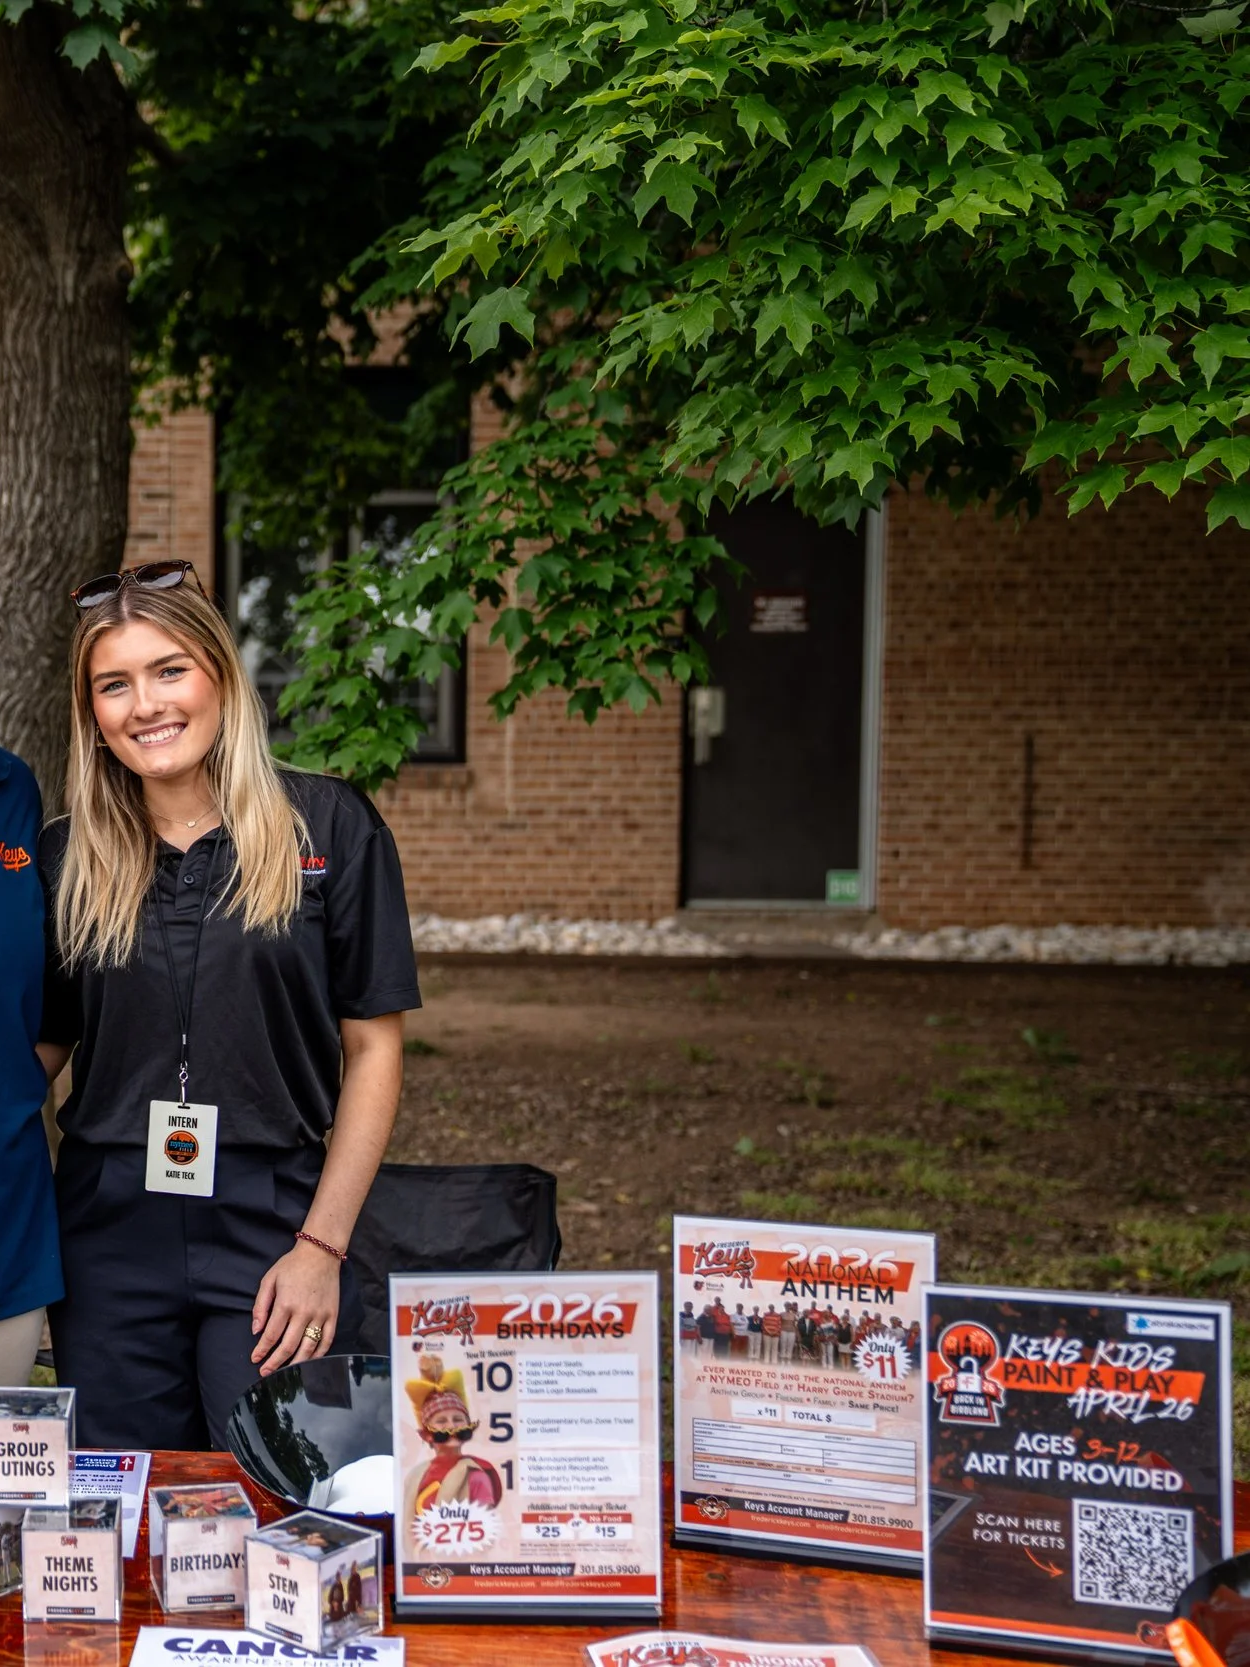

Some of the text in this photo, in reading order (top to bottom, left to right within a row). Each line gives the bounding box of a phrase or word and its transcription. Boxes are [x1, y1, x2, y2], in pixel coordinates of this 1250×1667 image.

[168, 1115, 198, 1129] INTERN
[165, 1170, 195, 1180] KATIE TECK
[716, 1240, 750, 1249] FREDERICK
[694, 1241, 756, 1276] Keys
[779, 1242, 899, 1280] 2026
[786, 1260, 891, 1284] NATIONAL
[780, 1277, 895, 1305] ANTHEM
[411, 1300, 477, 1338] Keys
[501, 1292, 624, 1325] 2026
[496, 1323, 625, 1340] BIRTHDAYS
[868, 1341, 896, 1355] Only
[1004, 1333, 1177, 1373] KEYS KIDS
[471, 1361, 513, 1393] 10
[863, 1353, 898, 1379] $11
[709, 1374, 751, 1387] NYMEO
[1003, 1362, 1176, 1394] PAINT & PLAY
[764, 1407, 832, 1423] $11 TOTAL $
[1066, 1387, 1197, 1425] APRIL 26
[488, 1412, 514, 1443] 5
[1015, 1431, 1077, 1457] AGES
[500, 1460, 514, 1490] 1
[963, 1452, 1184, 1492] ART KIT PROVIDED
[438, 1506, 470, 1520] Only
[537, 1514, 558, 1523] Food
[589, 1514, 622, 1523] No Food
[744, 1500, 914, 1529] Keys Account Manager 301.815.9900
[975, 1511, 1062, 1533] SCAN HERE
[422, 1520, 485, 1544] $275
[535, 1525, 561, 1538] $25
[595, 1525, 617, 1538] $15
[972, 1529, 1066, 1550] FOR TICKETS
[45, 1556, 94, 1572] THEME
[469, 1564, 641, 1577] Keys Account Manager 301.815.9900
[42, 1575, 98, 1592] NIGHTS
[268, 1573, 299, 1597] STEM
[272, 1595, 296, 1616] DAY
[163, 1637, 378, 1661] CANCR
[172, 1654, 294, 1667] AWARENESS
[748, 1654, 826, 1667] THOMAS
